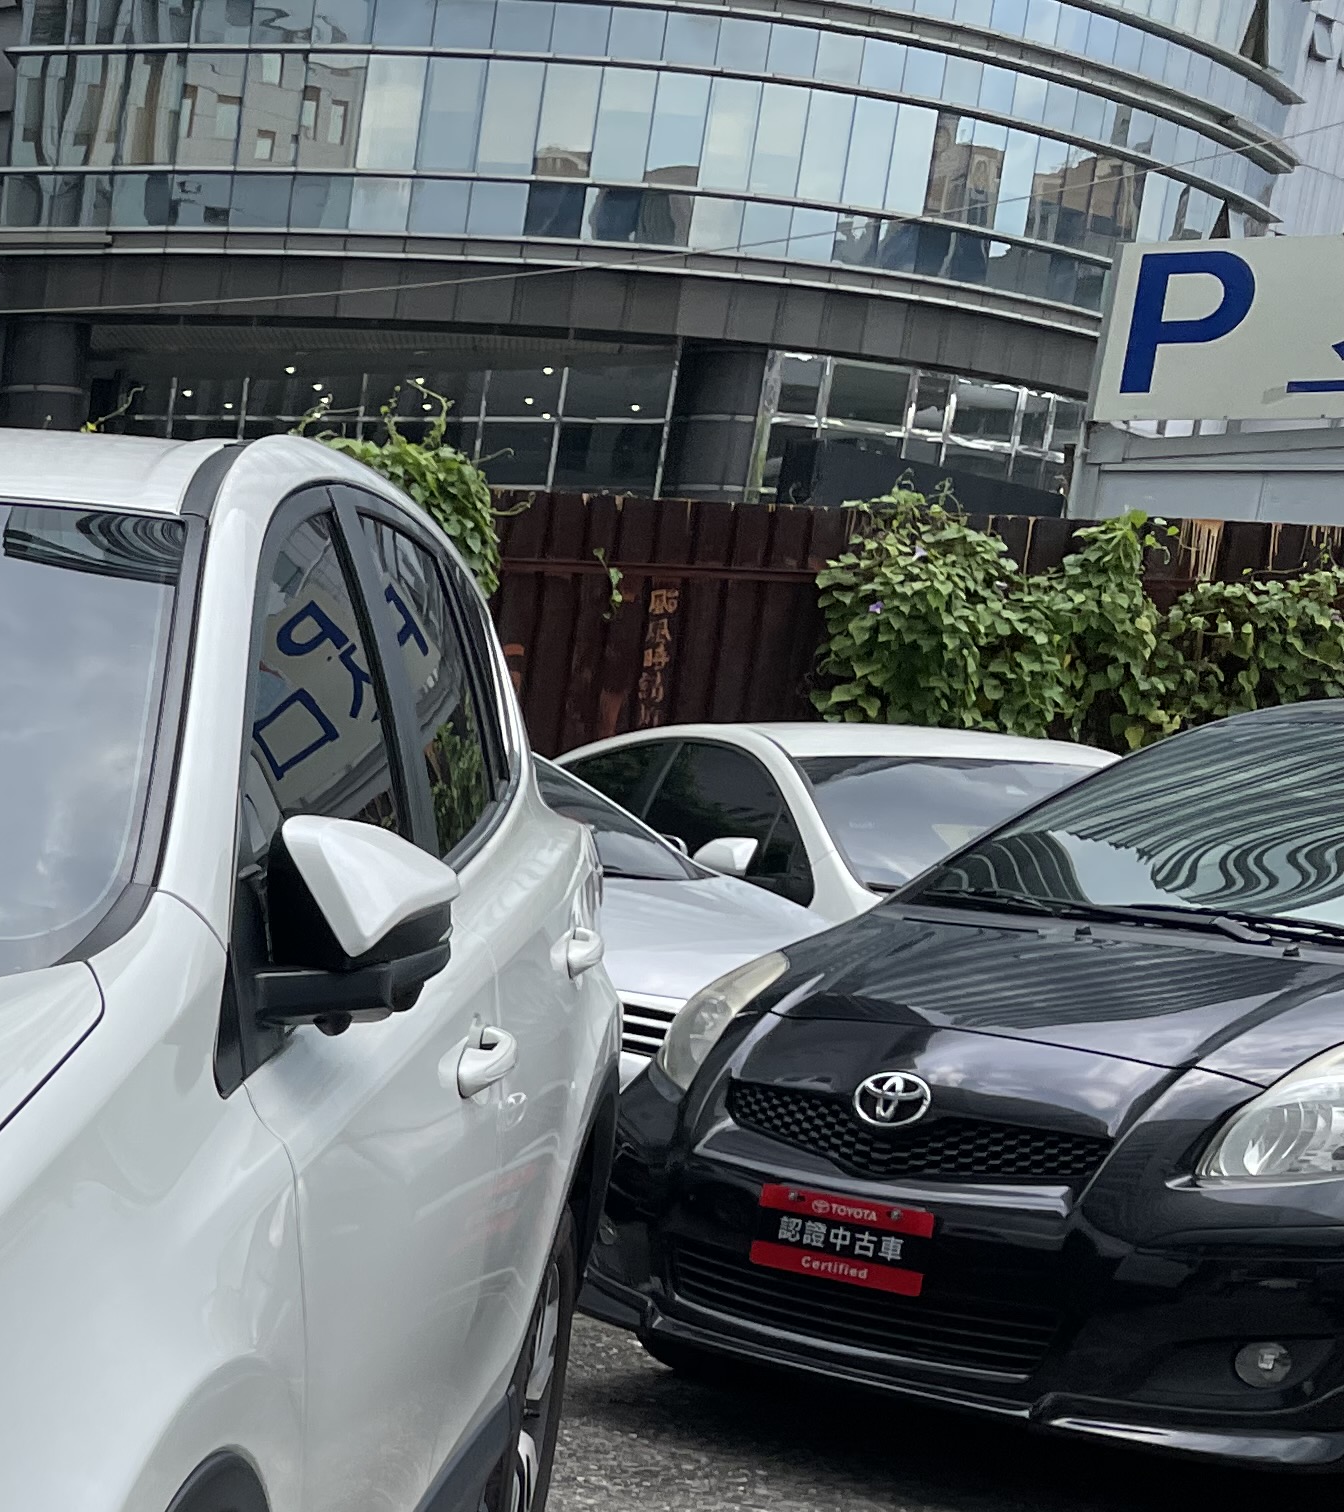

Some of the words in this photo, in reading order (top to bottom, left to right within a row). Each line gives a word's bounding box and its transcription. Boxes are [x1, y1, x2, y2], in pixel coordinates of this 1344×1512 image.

[1119, 250, 1256, 394] P
[831, 1202, 877, 1222] TOYOTA
[778, 1215, 905, 1262] 認證中古車
[801, 1255, 869, 1280] Certified
